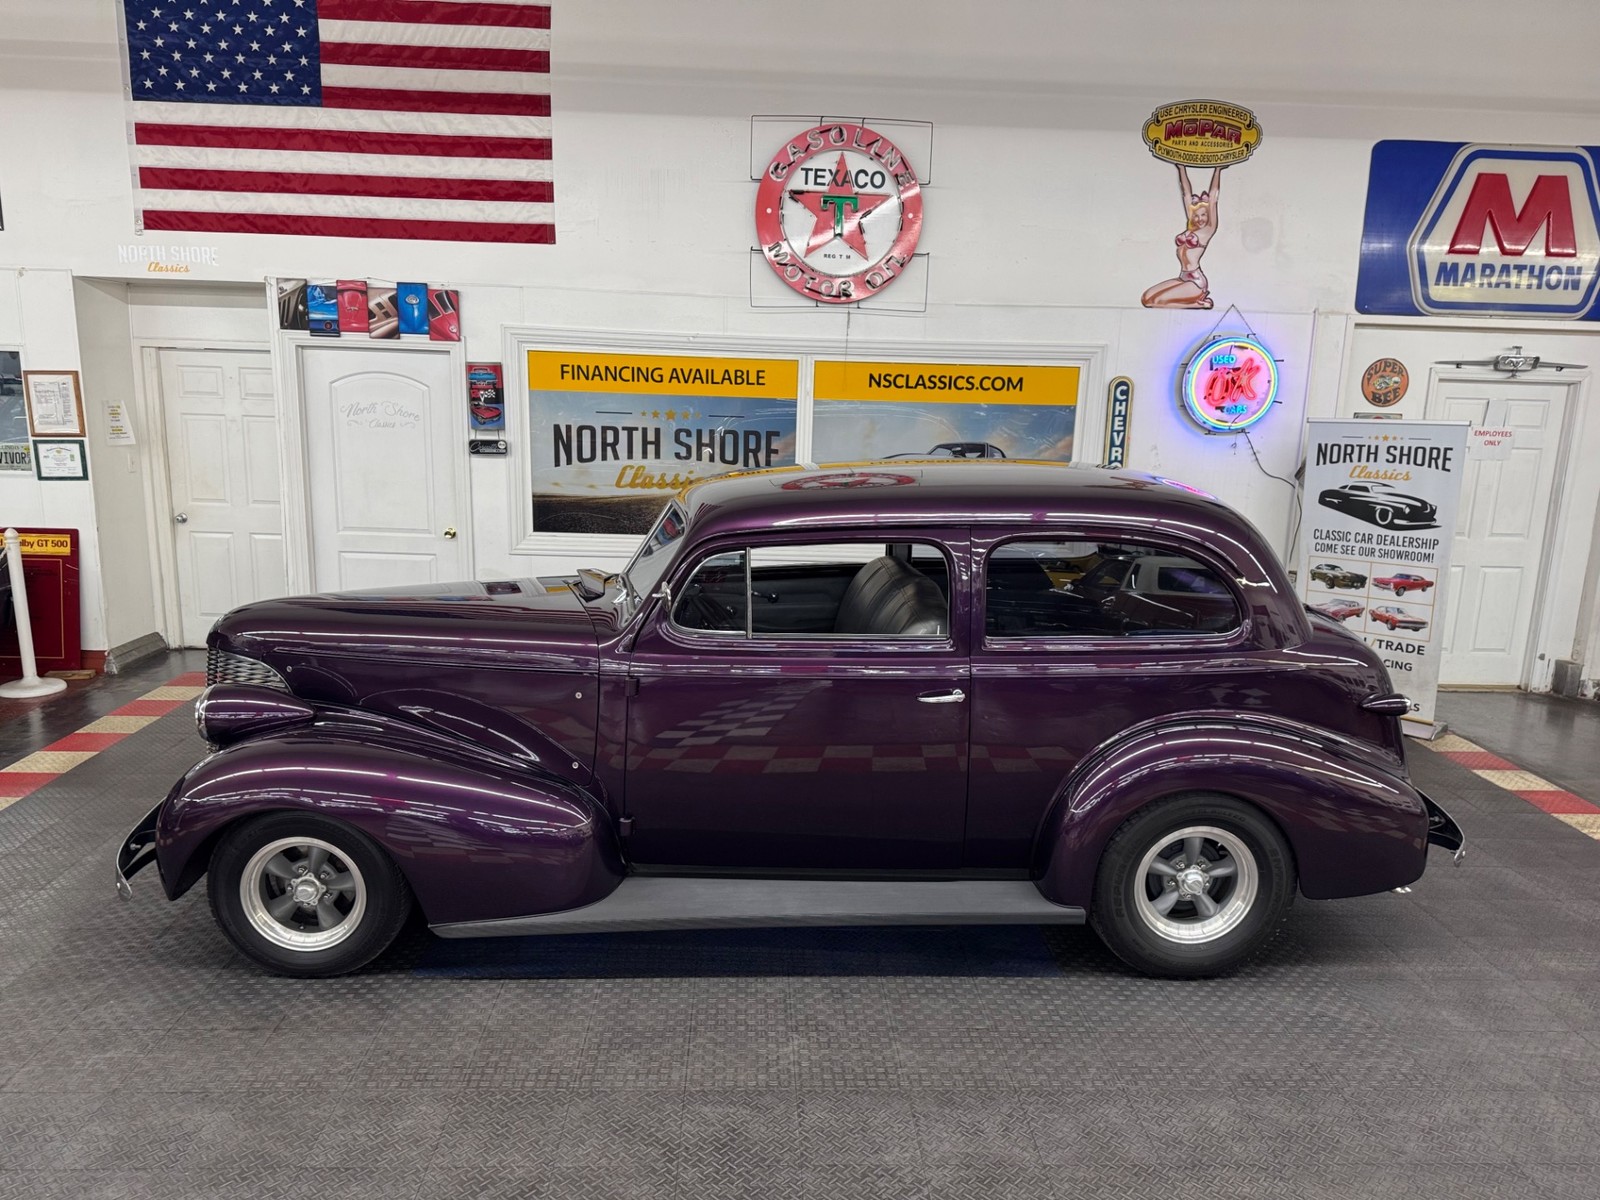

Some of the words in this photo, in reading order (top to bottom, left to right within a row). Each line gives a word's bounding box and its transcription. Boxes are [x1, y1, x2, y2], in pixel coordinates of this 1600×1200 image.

[1160, 108, 1174, 119] USE
[1174, 103, 1208, 116] CHRYSLER
[1209, 104, 1248, 121] ENGINEERED
[1164, 118, 1242, 144] MOPAR
[1171, 139, 1187, 147] PARTS
[1201, 140, 1234, 148] ACCESSORIES
[768, 124, 917, 191] GASOLINE
[800, 167, 887, 189] TEXACO
[820, 194, 860, 238] T
[1446, 172, 1577, 258] M
[117, 244, 167, 264] NORTH
[170, 245, 220, 267] SHORE
[147, 261, 190, 273] Classics
[767, 241, 855, 301] MOTOR
[865, 253, 909, 291] OIL
[1434, 261, 1583, 292] MARATHON
[1212, 354, 1237, 365] USED
[560, 363, 664, 384] FINANCING
[668, 367, 766, 386] AVAILABLE
[868, 372, 1024, 393] NSCLASSICS.COM
[1204, 357, 1262, 408] OK
[1366, 360, 1406, 386] SUPER
[1370, 387, 1401, 405] BEE
[339, 402, 379, 419] North
[381, 400, 422, 422] Shore
[364, 418, 397, 429] Classics
[1474, 429, 1513, 438] EMPLOYEES
[554, 424, 661, 467] NORTH
[674, 427, 782, 468] SHORE
[1483, 439, 1502, 447] ONLY
[1316, 442, 1380, 467] NORTH
[1385, 444, 1454, 473] SHORE
[1349, 465, 1413, 482] Classics
[36, 539, 50, 548] GT
[51, 539, 68, 548] 500
[1313, 528, 1352, 543] CLASSIC
[1354, 531, 1374, 545] CAR
[1376, 533, 1440, 550] DEALERSHIP
[1314, 542, 1339, 555] COME
[1340, 544, 1356, 556] SEE
[1358, 546, 1376, 558] OUR
[1377, 547, 1435, 564] SHOWROOM!
